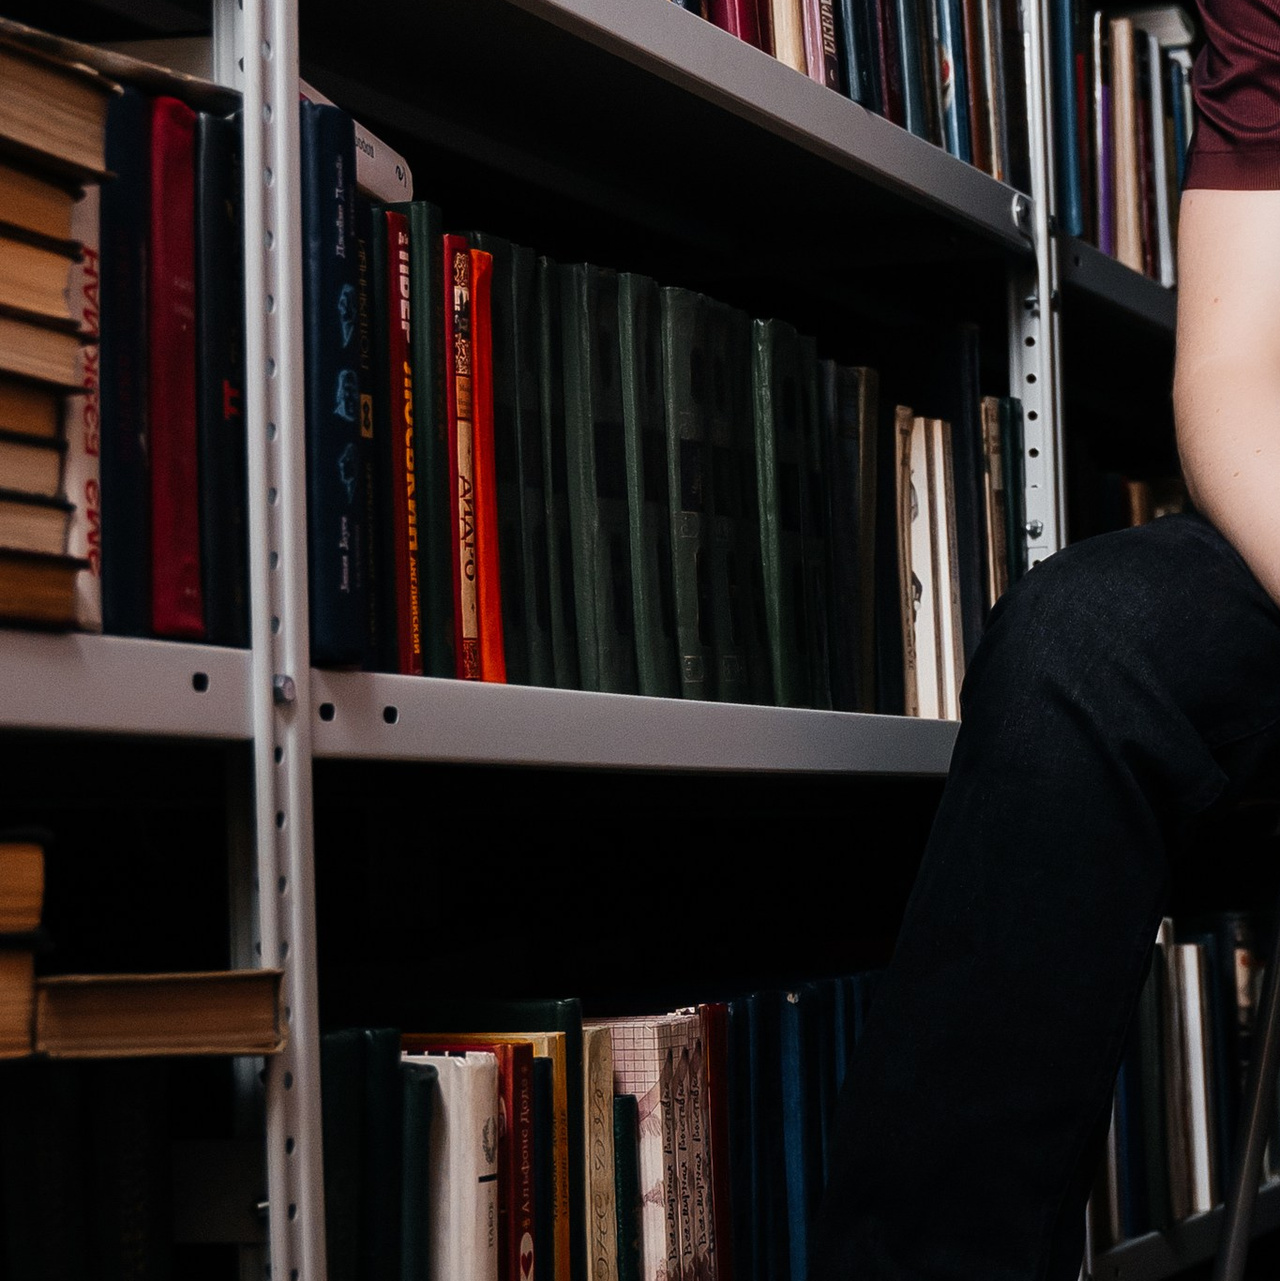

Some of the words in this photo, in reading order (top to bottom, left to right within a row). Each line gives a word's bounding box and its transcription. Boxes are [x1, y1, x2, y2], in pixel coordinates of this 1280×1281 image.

[457, 475, 476, 582] ДИДРО
[409, 556, 421, 655] АНГЛИЙСКИЙ
[519, 1077, 530, 1124] Доде
[520, 1128, 531, 1213] Альфонс
